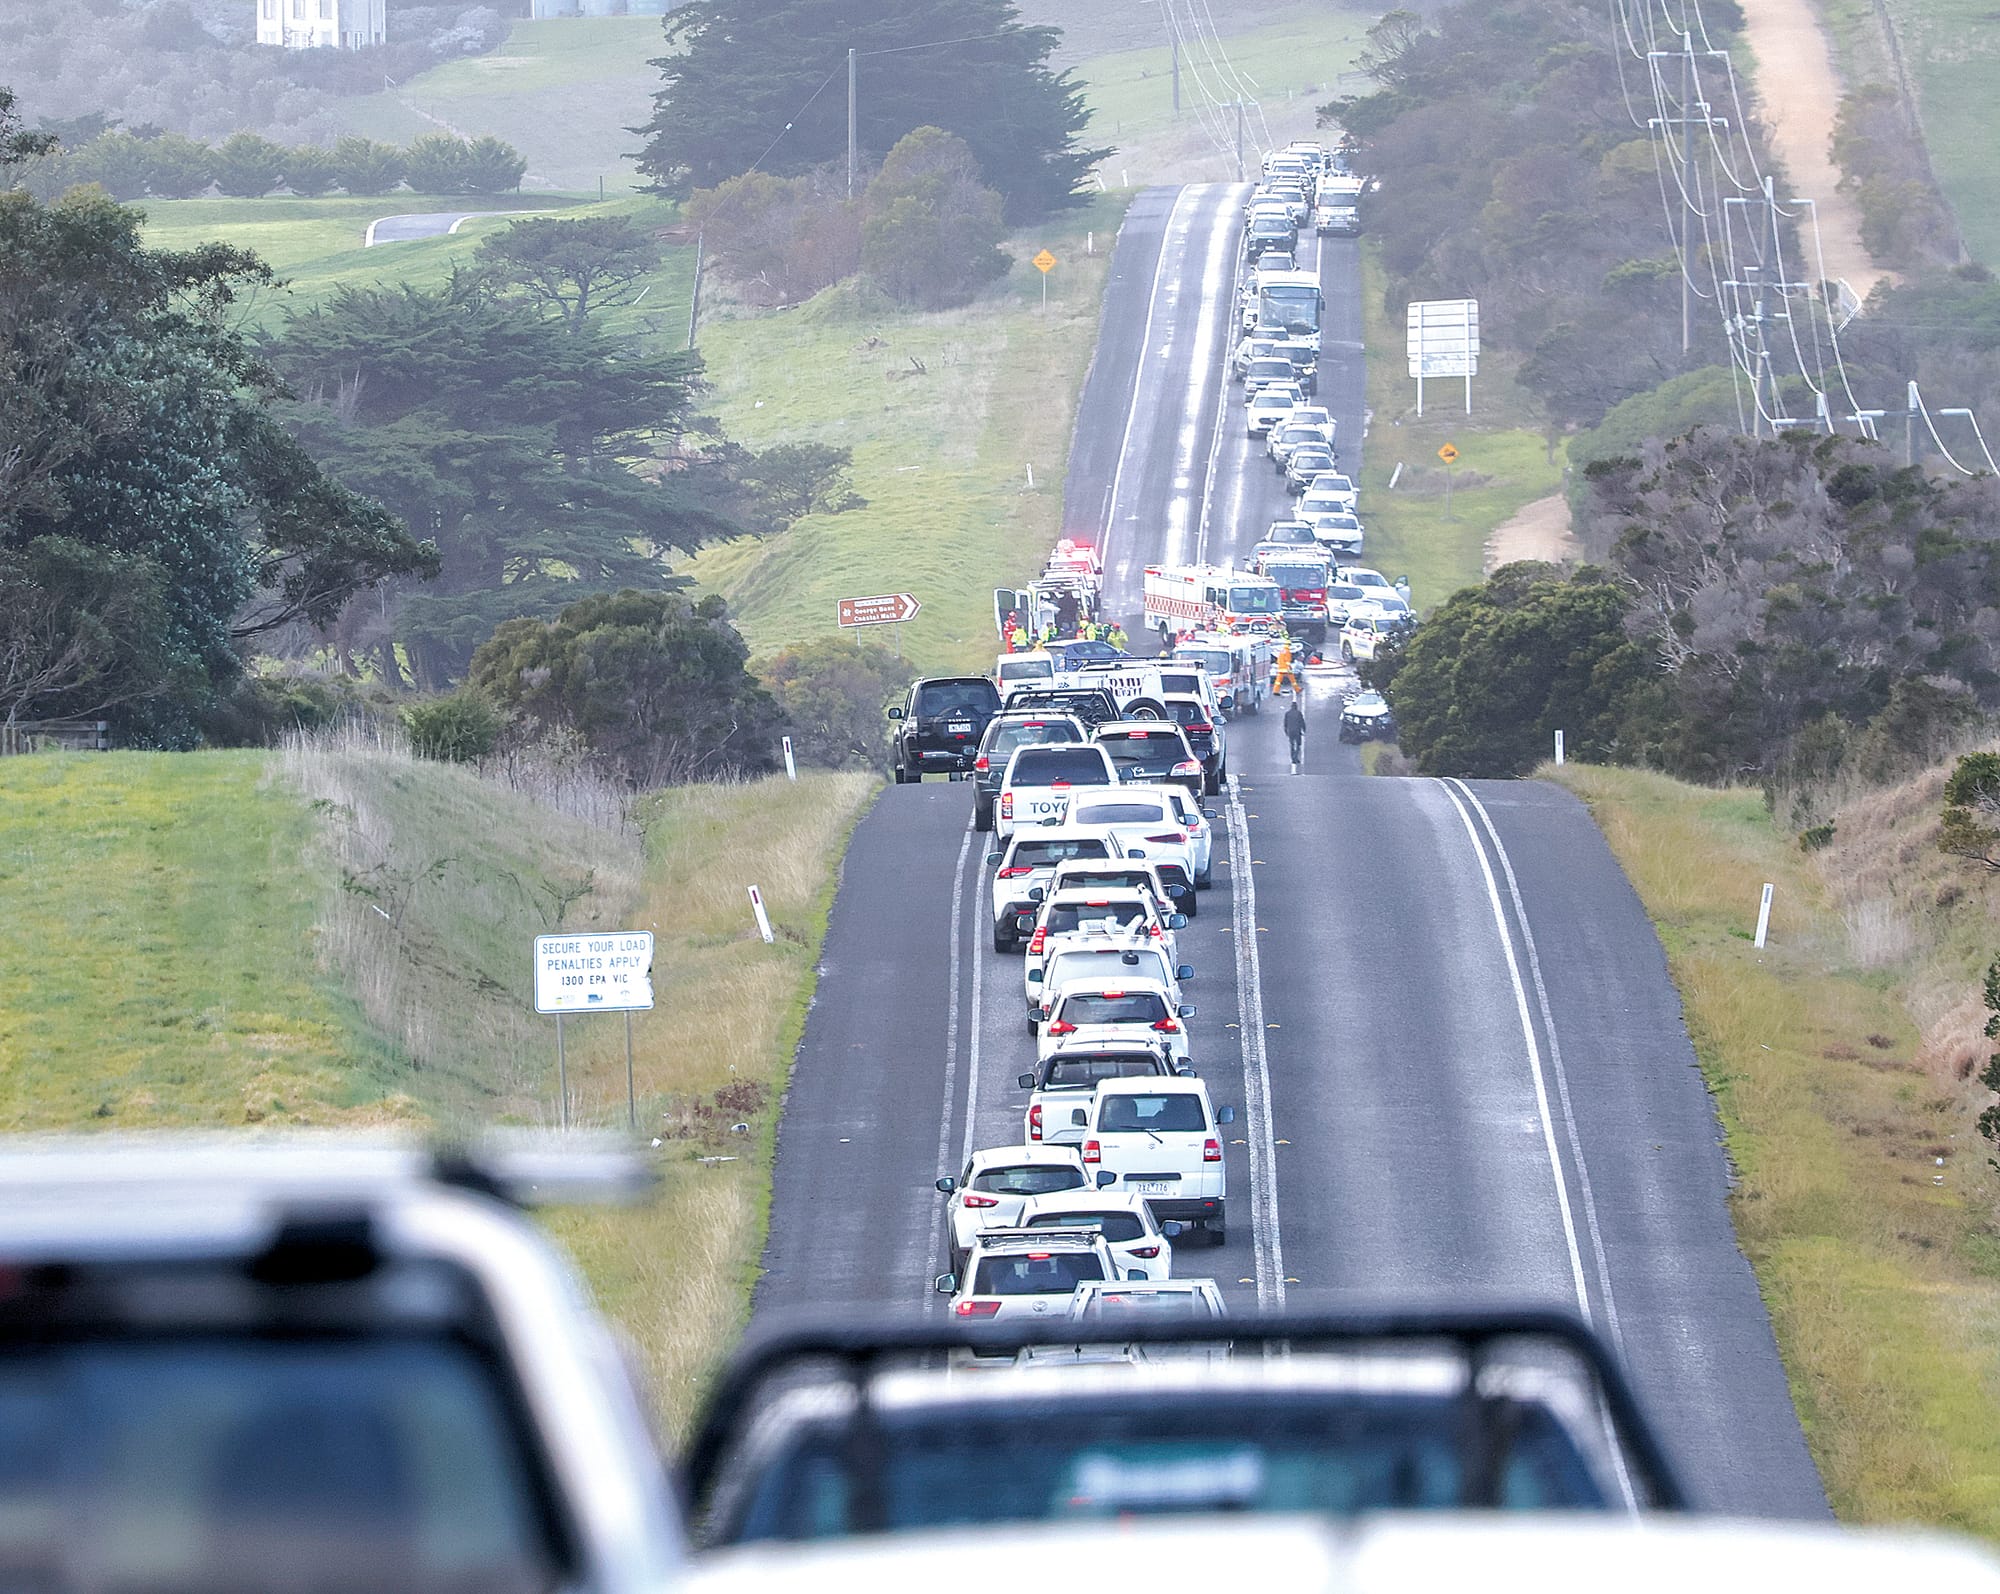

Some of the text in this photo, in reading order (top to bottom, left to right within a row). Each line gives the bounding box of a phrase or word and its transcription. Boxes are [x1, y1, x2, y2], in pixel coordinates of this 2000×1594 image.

[542, 940, 646, 954] SECURE YOUR LOAD
[547, 956, 641, 970] PENALTIES APPLY
[561, 974, 628, 986] 1300 EPA VIC
